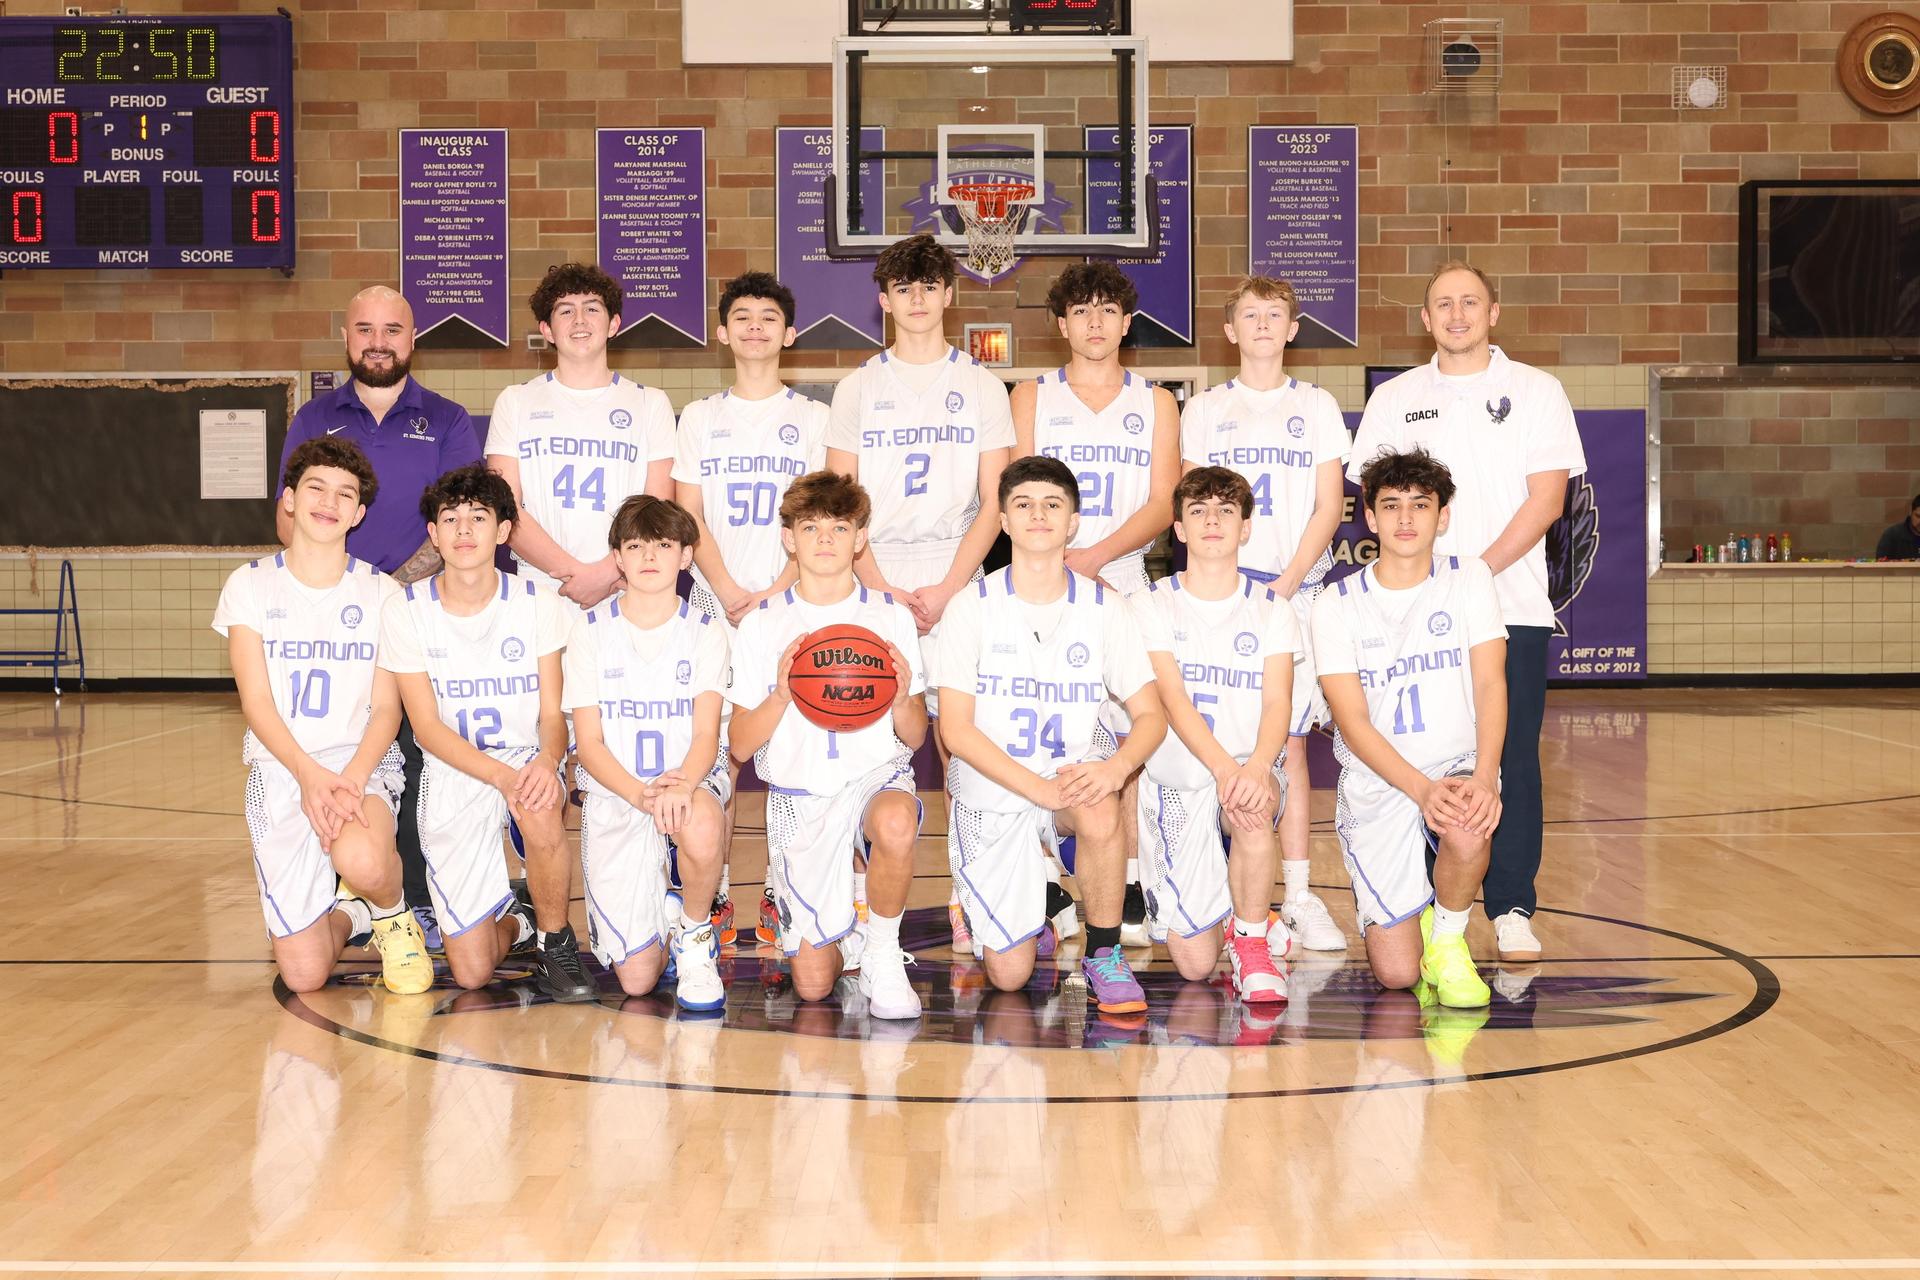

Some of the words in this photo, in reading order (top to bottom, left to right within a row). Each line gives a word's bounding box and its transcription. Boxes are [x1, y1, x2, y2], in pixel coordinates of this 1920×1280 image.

[59, 29, 215, 80] 22:50
[7, 88, 66, 104] HOME
[110, 95, 167, 107] PERIOD
[206, 87, 269, 103] GUEST
[104, 124, 114, 136] P
[140, 114, 147, 140] 1
[161, 123, 171, 136] P
[49, 112, 78, 163] 0
[250, 111, 279, 162] 0
[420, 136, 488, 146] INAUGURAL
[624, 136, 658, 145] CLASS
[662, 136, 678, 145] OF
[1150, 135, 1164, 144] OF
[1277, 134, 1311, 143] CLASS
[1315, 134, 1330, 143] OF
[111, 148, 164, 160] BONUS
[438, 146, 472, 156] CLASS
[638, 146, 665, 155] 2014
[1290, 144, 1317, 153] 2023
[84, 170, 140, 183] PLAYER
[163, 170, 203, 183] FOUL
[13, 191, 42, 242] 0
[251, 190, 280, 241] 0
[0, 251, 50, 263] SCORE
[99, 251, 149, 263] MATCH
[181, 250, 233, 263] SCORE
[970, 331, 1002, 361] EXIT
[1405, 408, 1439, 424] COACH
[904, 453, 931, 498] 2
[553, 464, 606, 512] 44
[1077, 472, 1115, 517] 21
[727, 481, 778, 527] 50
[812, 648, 884, 671] Wilson
[1560, 648, 1569, 658] A
[1572, 647, 1595, 658] GIFT
[1598, 647, 1614, 658] OF
[1616, 647, 1636, 658] THE
[1559, 663, 1592, 674] CLASS
[1594, 663, 1611, 673] OF
[1613, 662, 1640, 673] 2012
[289, 669, 331, 719] 10
[822, 684, 875, 701] NCAA
[1393, 684, 1426, 735] 11
[456, 707, 506, 751] 12
[1006, 708, 1066, 759] 34
[636, 730, 665, 777] 0
